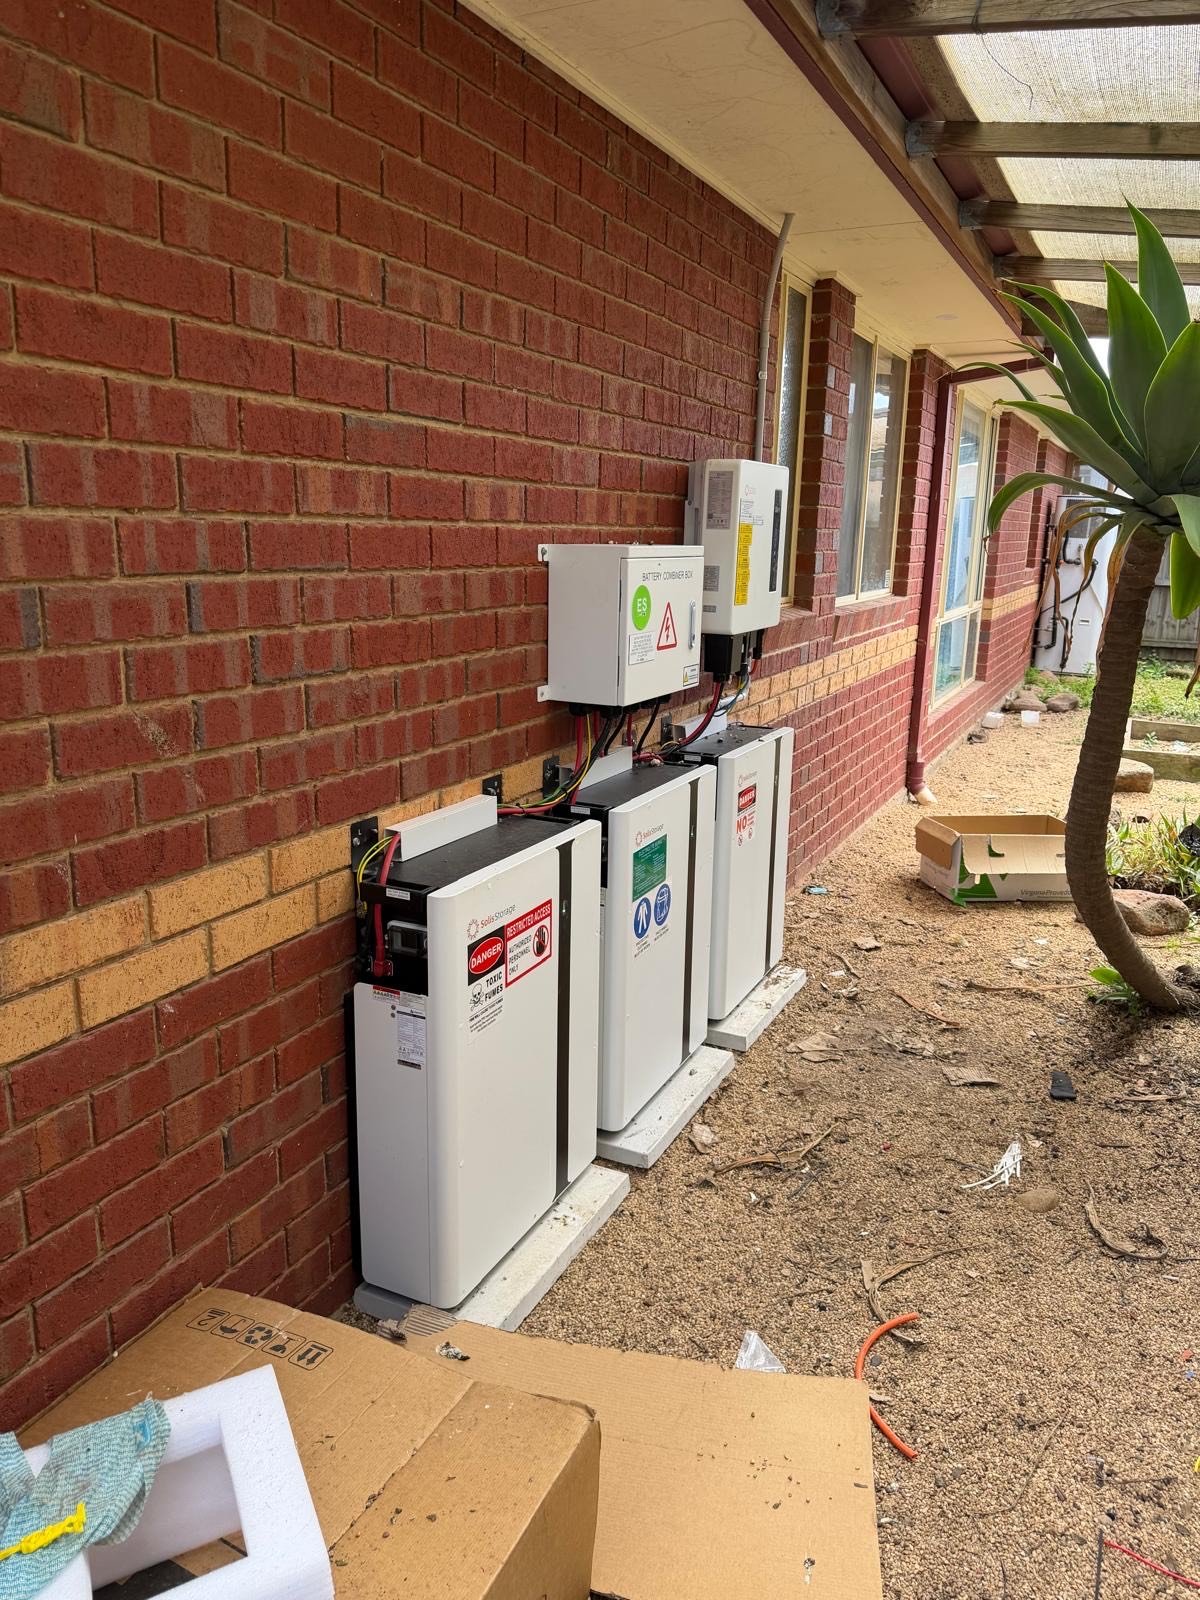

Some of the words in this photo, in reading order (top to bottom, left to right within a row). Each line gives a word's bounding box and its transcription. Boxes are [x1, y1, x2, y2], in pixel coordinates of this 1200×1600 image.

[642, 571, 662, 582] BATTERY
[685, 570, 693, 580] BOX
[637, 598, 647, 612] ES
[736, 815, 748, 833] NO
[506, 913, 534, 939] RESTRICTED
[534, 904, 551, 922] ACCESS
[470, 943, 502, 969] DANGER
[508, 946, 531, 965] PERSONNEL
[508, 963, 519, 976] ONLY
[486, 971, 503, 988] TOXIC
[484, 983, 504, 1002] FUMES
